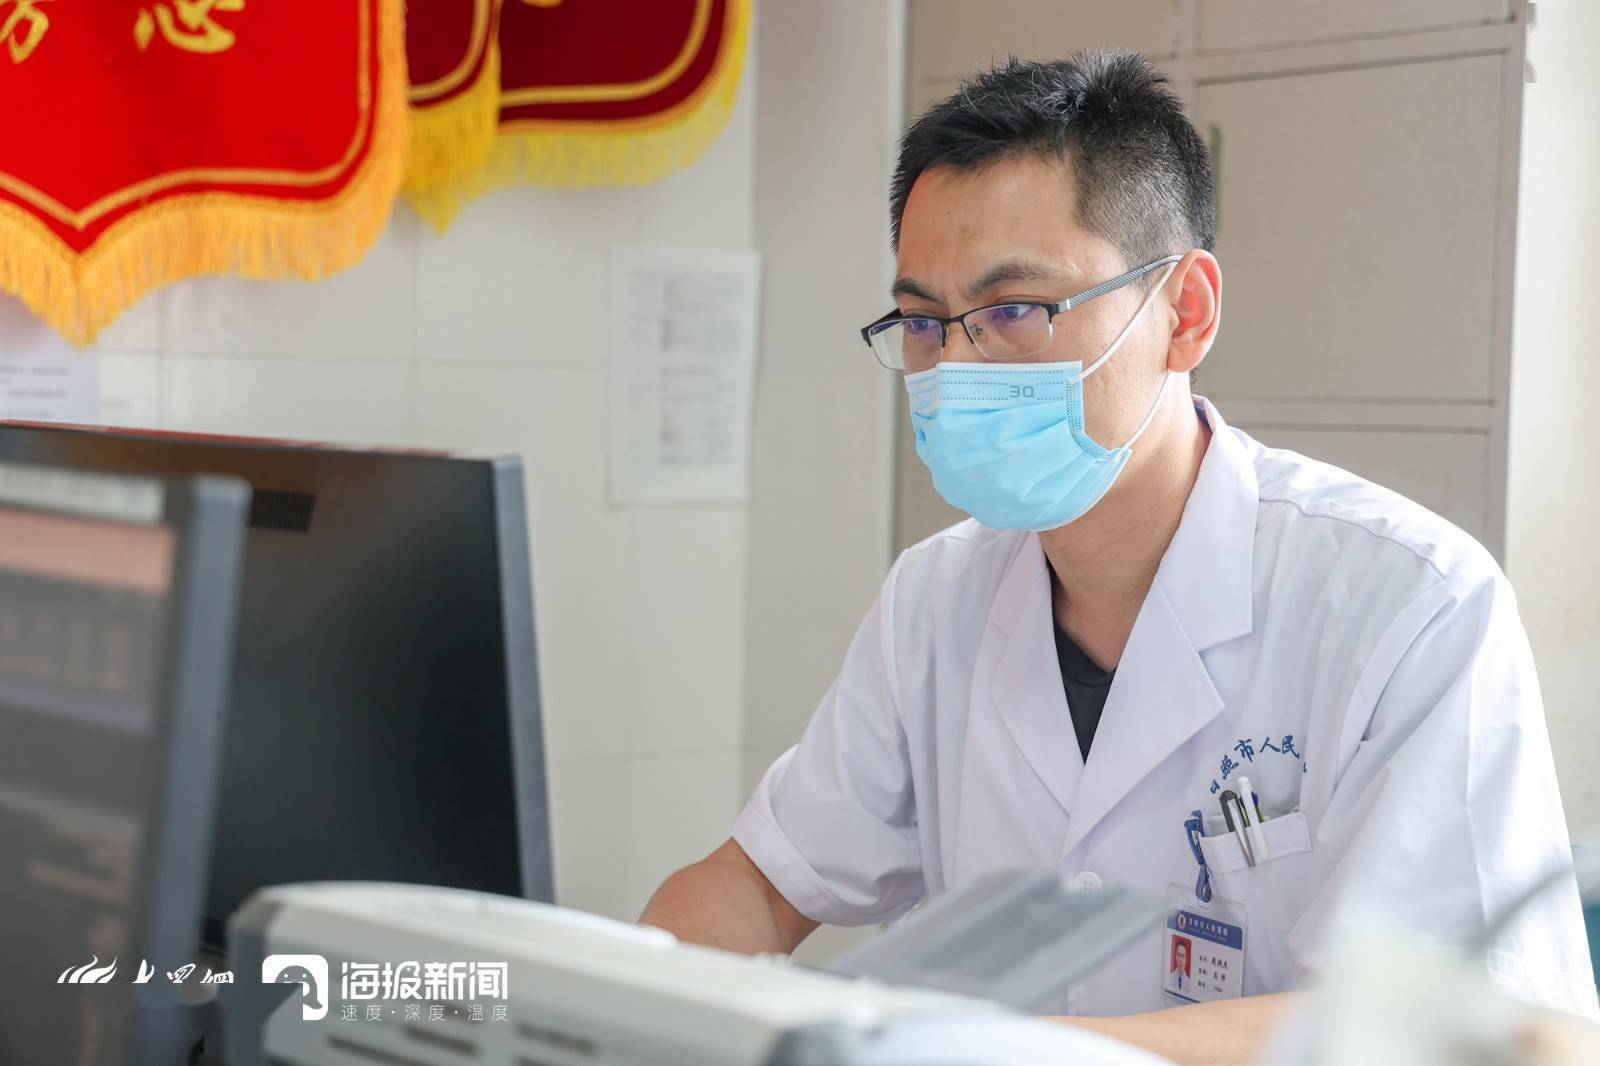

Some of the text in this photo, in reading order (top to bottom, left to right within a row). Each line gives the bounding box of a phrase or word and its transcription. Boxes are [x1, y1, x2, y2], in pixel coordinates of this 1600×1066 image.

[1009, 385, 1036, 398] 3Q
[1209, 734, 1308, 794] 日照市人民
